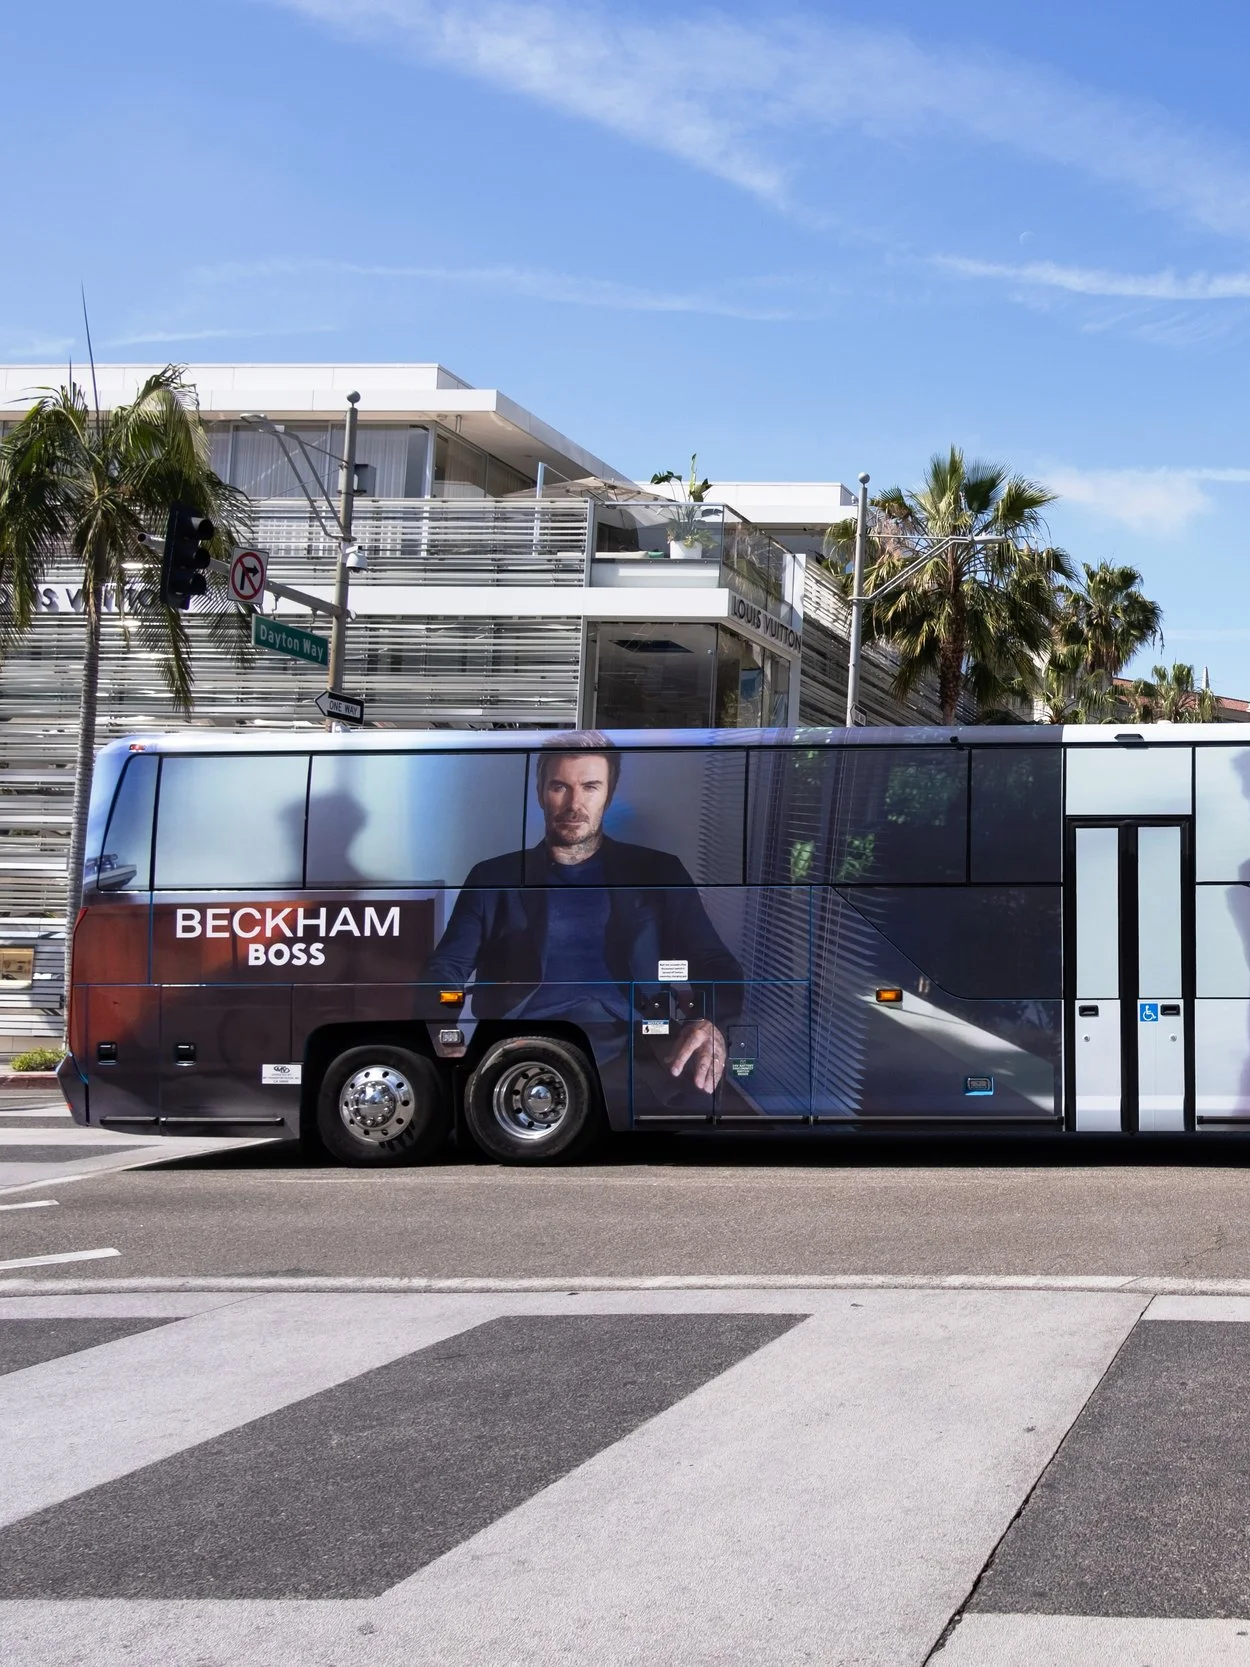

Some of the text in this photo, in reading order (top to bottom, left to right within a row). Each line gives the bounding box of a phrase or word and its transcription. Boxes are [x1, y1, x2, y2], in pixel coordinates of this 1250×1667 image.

[732, 595, 801, 653] LOUIS VUITTON
[260, 624, 324, 661] Dayton Way
[329, 701, 359, 716] ONE WAY
[175, 906, 401, 939] BECKHAM
[248, 942, 326, 966] BOSS
